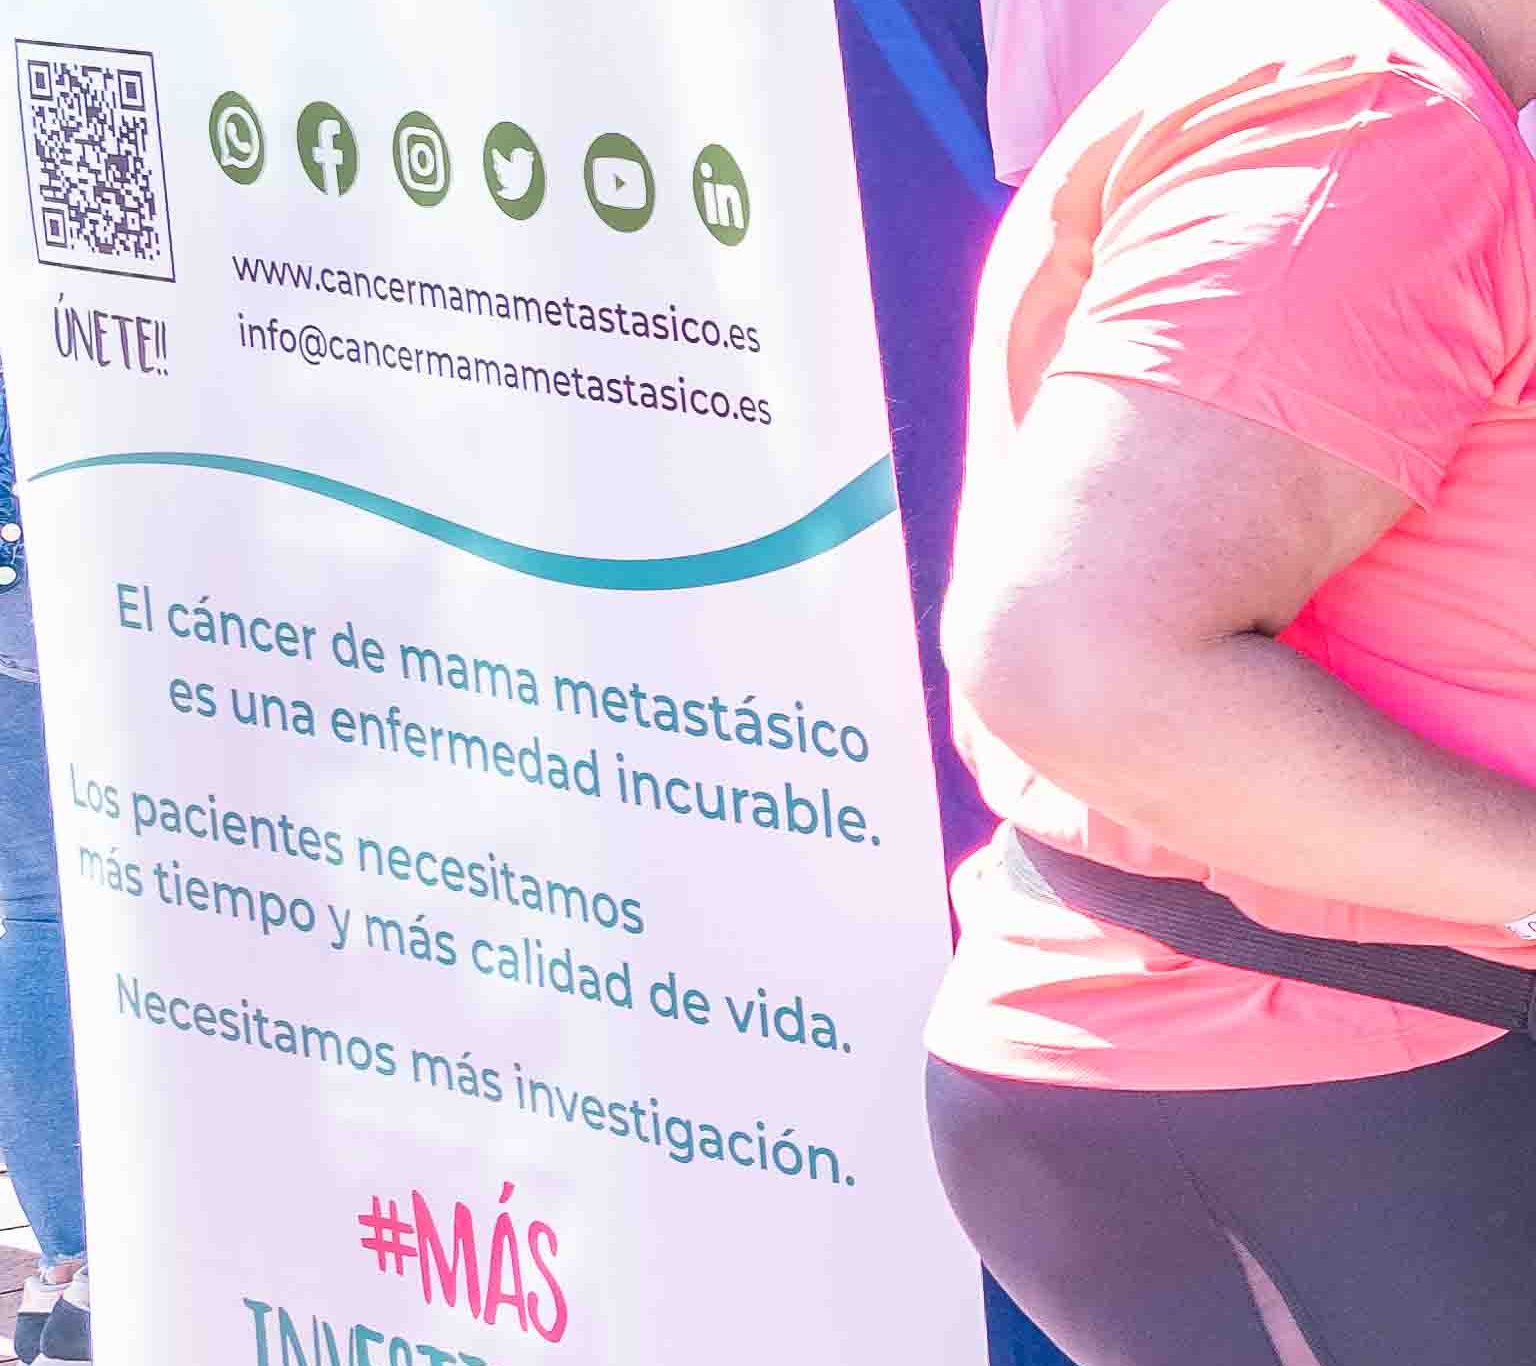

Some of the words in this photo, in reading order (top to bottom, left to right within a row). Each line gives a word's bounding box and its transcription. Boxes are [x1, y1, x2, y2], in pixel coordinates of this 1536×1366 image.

[53, 291, 170, 377] ÚNETE!!
[231, 251, 763, 355] www.cancermamametastasico.es
[237, 311, 775, 427] info@cancermamametastasico.es
[115, 582, 154, 632] El
[166, 595, 316, 663] cáncer
[331, 621, 386, 675] de
[399, 646, 540, 707] mama
[553, 675, 871, 765] metastásico
[169, 673, 217, 719] es
[231, 690, 315, 738] una
[330, 707, 601, 798] enfermedad
[616, 752, 882, 847] incurable.
[68, 761, 121, 821] Los
[131, 784, 344, 868] pacientes
[358, 834, 646, 937] necesitamos
[78, 842, 144, 900] más
[152, 861, 316, 938] tiempo
[328, 903, 351, 951] y
[365, 914, 458, 968] más
[470, 933, 634, 1012] calidad
[649, 970, 711, 1027] de
[725, 988, 853, 1055] vida.
[114, 972, 396, 1077] Necesitamos
[410, 1044, 504, 1106] más
[514, 1063, 857, 1189] investigación.
[357, 1179, 569, 1344] #MÁS
